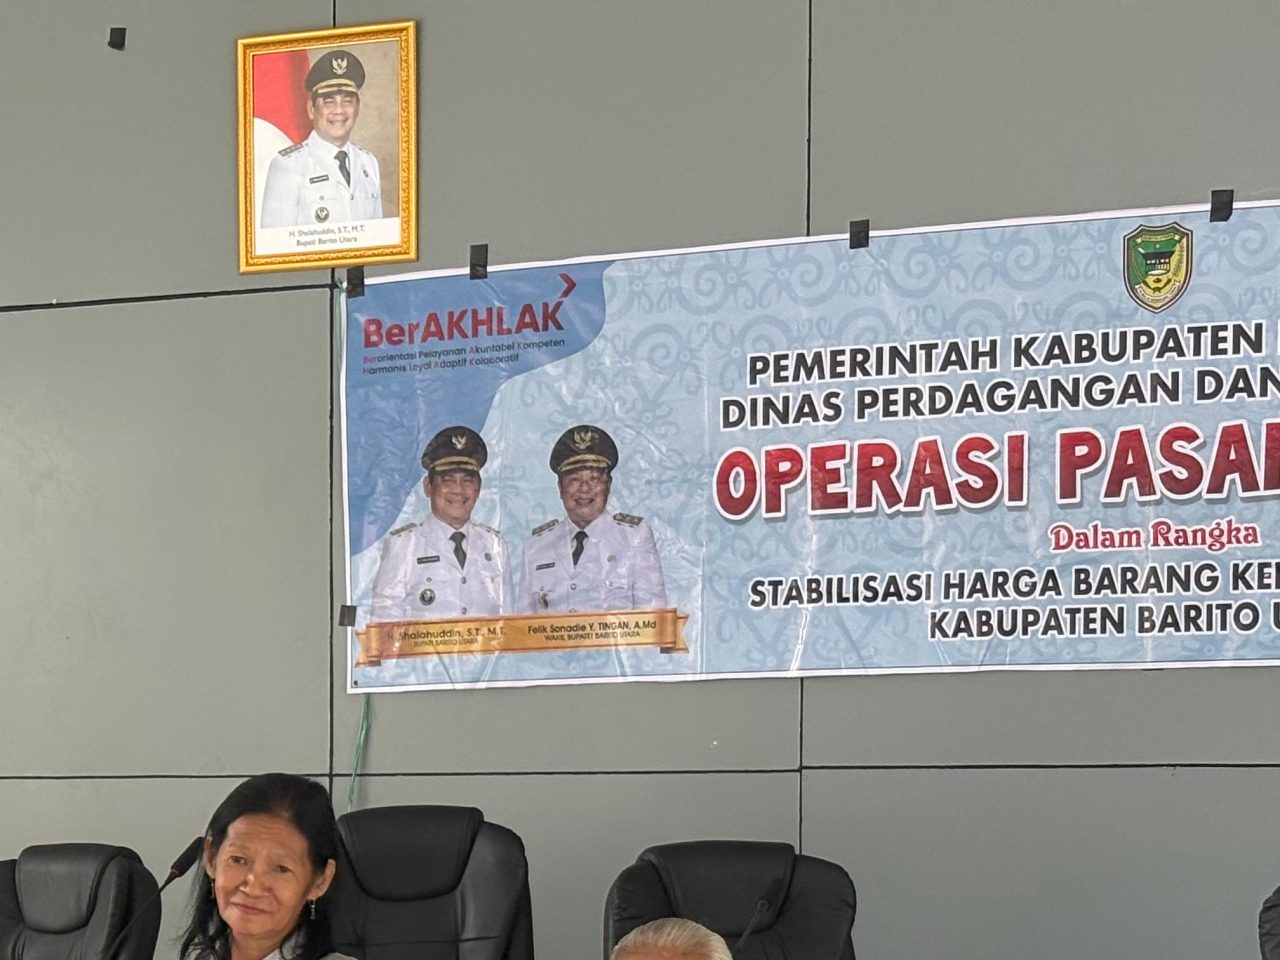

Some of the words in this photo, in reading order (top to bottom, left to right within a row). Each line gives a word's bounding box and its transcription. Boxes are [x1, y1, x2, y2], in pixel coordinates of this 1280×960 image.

[363, 300, 565, 349] BerAKHLAK
[418, 347, 466, 360] Pelayanan
[470, 342, 516, 354] Akuntabel
[517, 338, 566, 351] Kompeten
[434, 357, 468, 370] Adaptif
[748, 338, 999, 386] PEMERINTAH
[1012, 322, 1264, 369] KABUPATEN
[721, 391, 844, 430] DINAS
[856, 371, 1181, 420] PERDAGANGAN
[715, 433, 1025, 517] OPERASI
[1051, 523, 1143, 551] Dalam
[1151, 518, 1260, 552] Rangka
[749, 573, 933, 608] STABILISASI
[943, 568, 1063, 601] HARGA
[1073, 562, 1220, 597] BARANG
[1231, 561, 1280, 592] KE
[487, 626, 507, 636] M.T.
[929, 606, 1126, 639] KABUPATEN
[1137, 601, 1261, 634] BARITO
